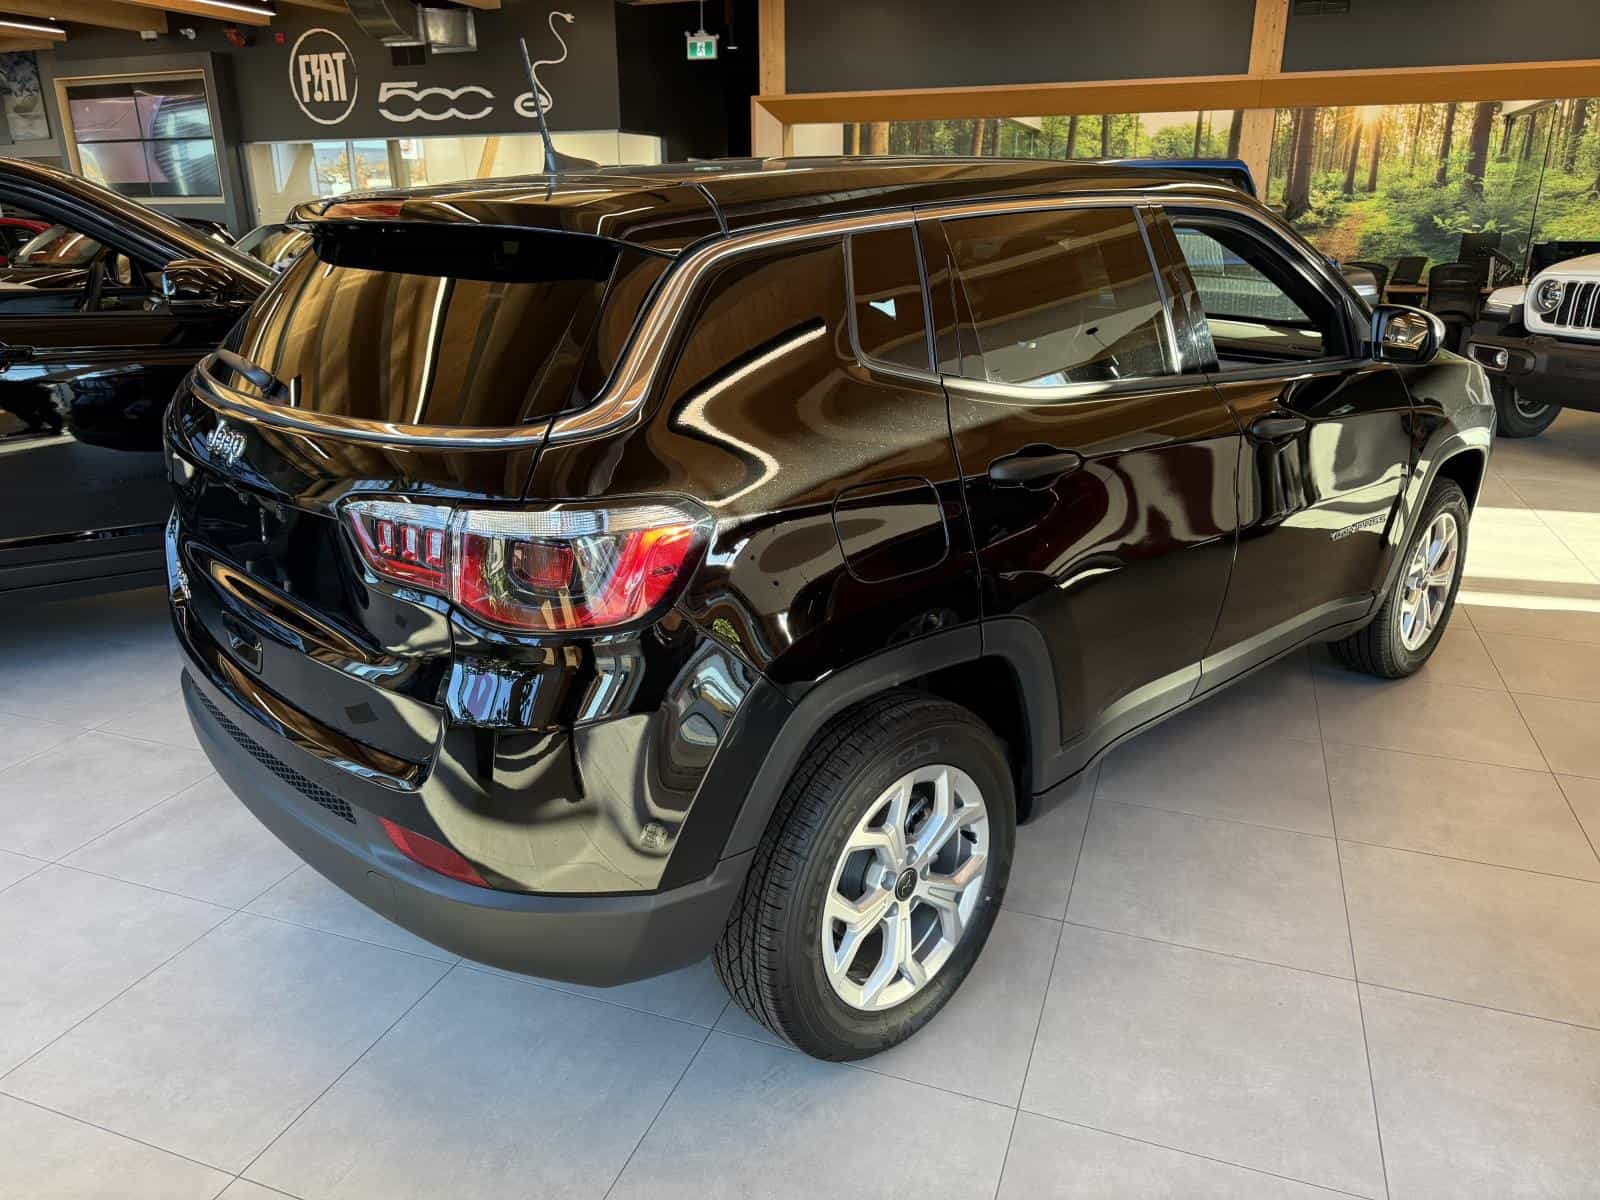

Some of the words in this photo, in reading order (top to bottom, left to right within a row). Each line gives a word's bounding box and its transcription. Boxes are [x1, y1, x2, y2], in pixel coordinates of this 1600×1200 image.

[298, 52, 348, 102] FIAT
[378, 81, 495, 122] 500
[206, 420, 247, 464] Jeep
